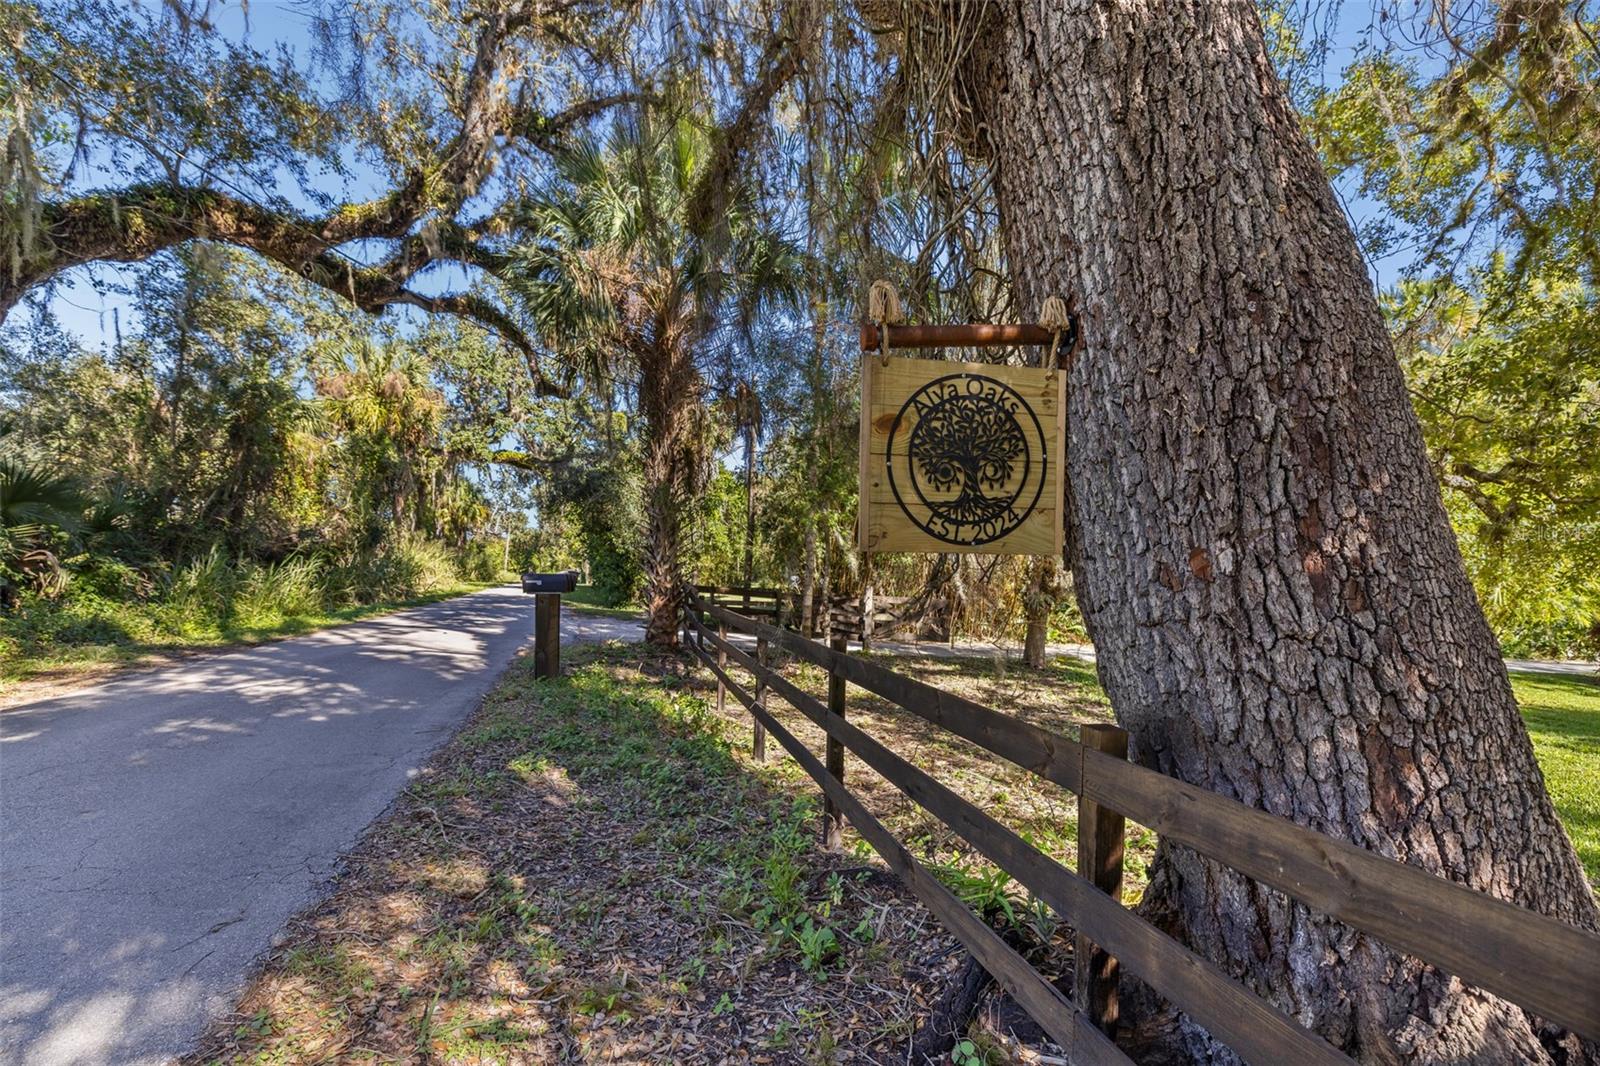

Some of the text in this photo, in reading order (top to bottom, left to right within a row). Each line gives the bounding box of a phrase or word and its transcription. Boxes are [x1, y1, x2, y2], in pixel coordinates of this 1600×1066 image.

[913, 379, 1020, 417] Alva Oaks
[924, 509, 1020, 542] EST. 2024
